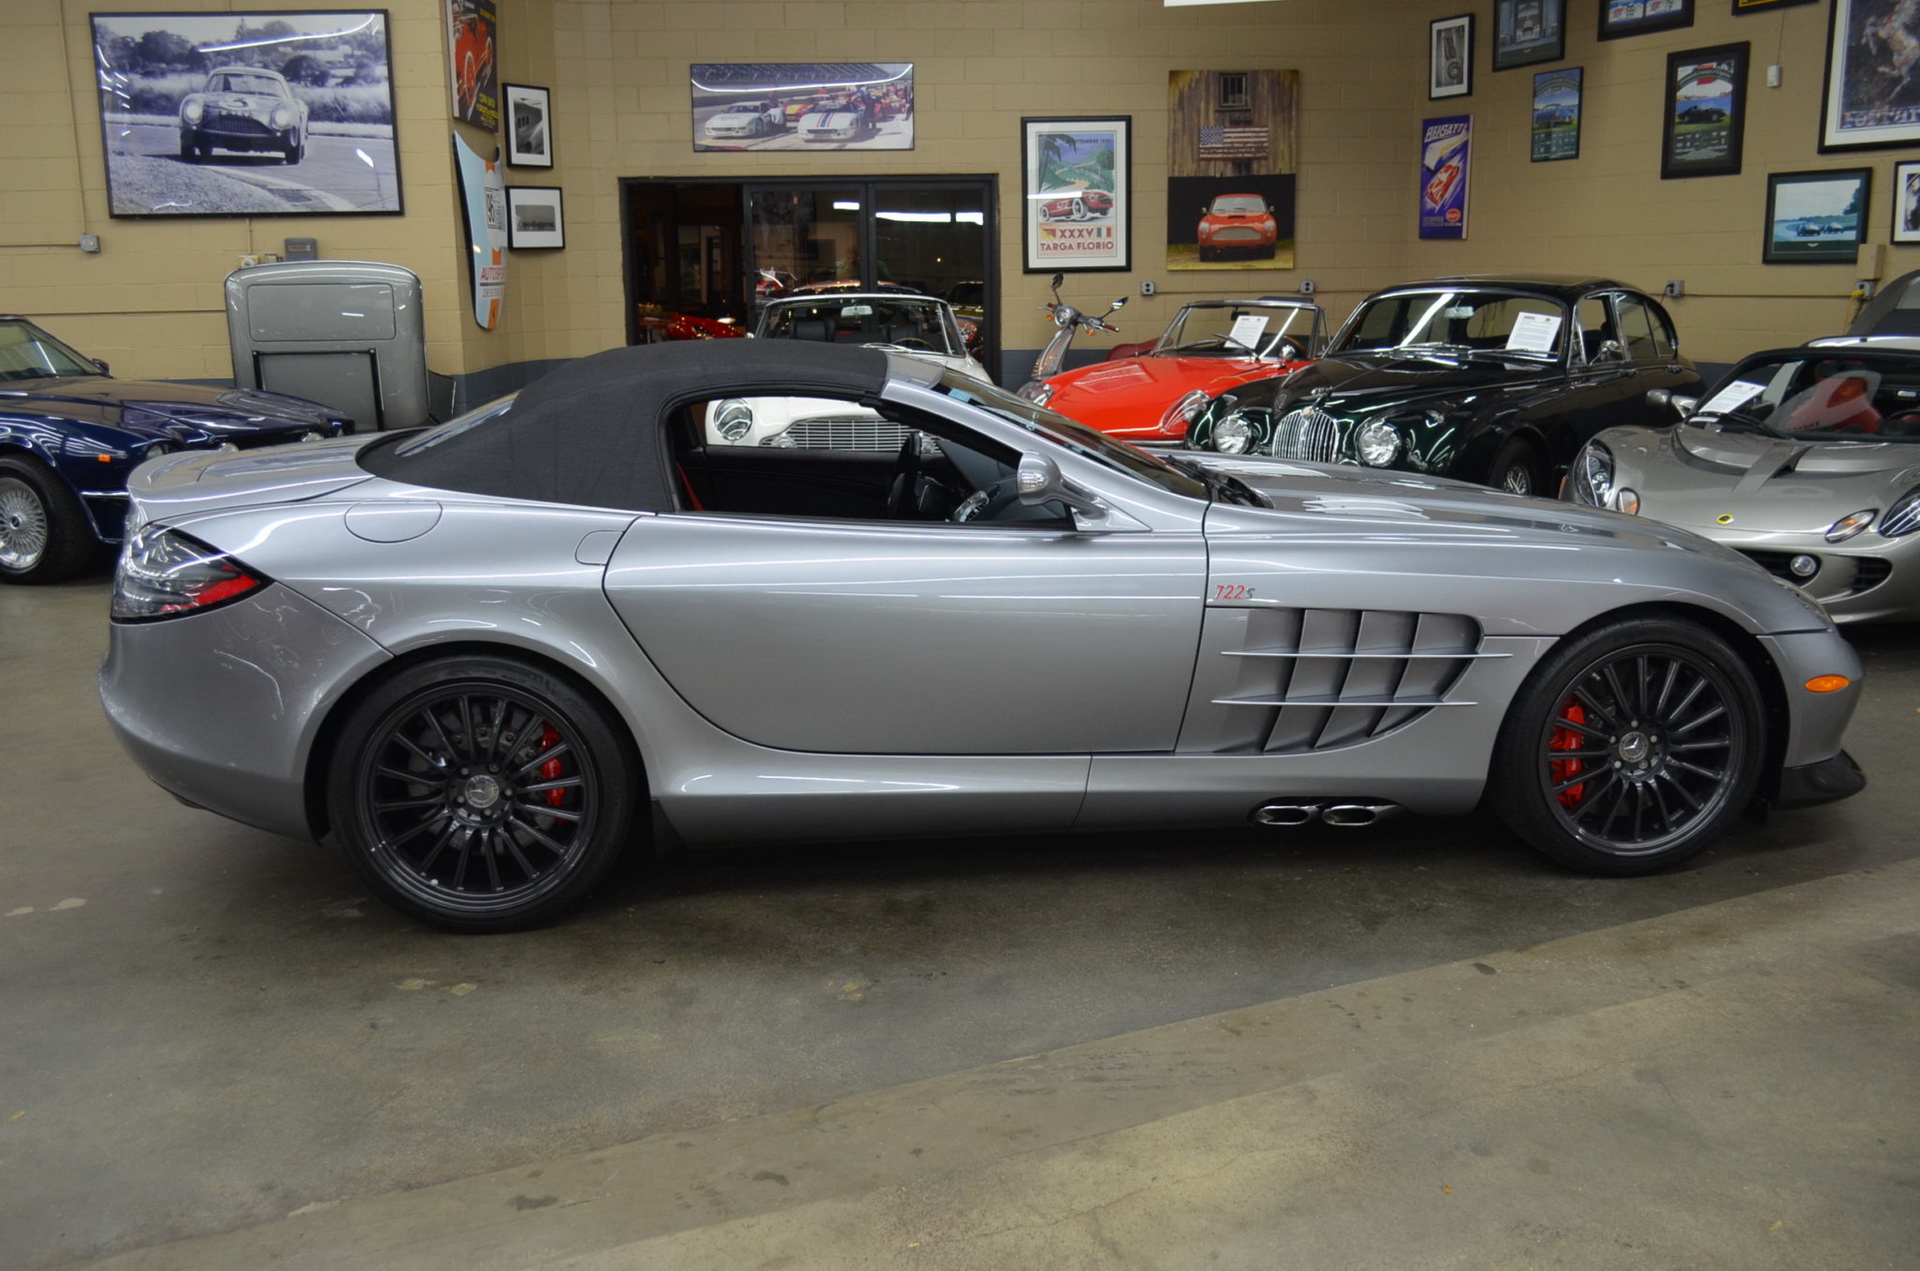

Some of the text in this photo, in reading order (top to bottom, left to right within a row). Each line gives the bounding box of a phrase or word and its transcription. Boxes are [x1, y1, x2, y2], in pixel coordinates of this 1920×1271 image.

[1060, 228, 1094, 239] XXXV
[1040, 241, 1114, 251] TARGA FLORIO
